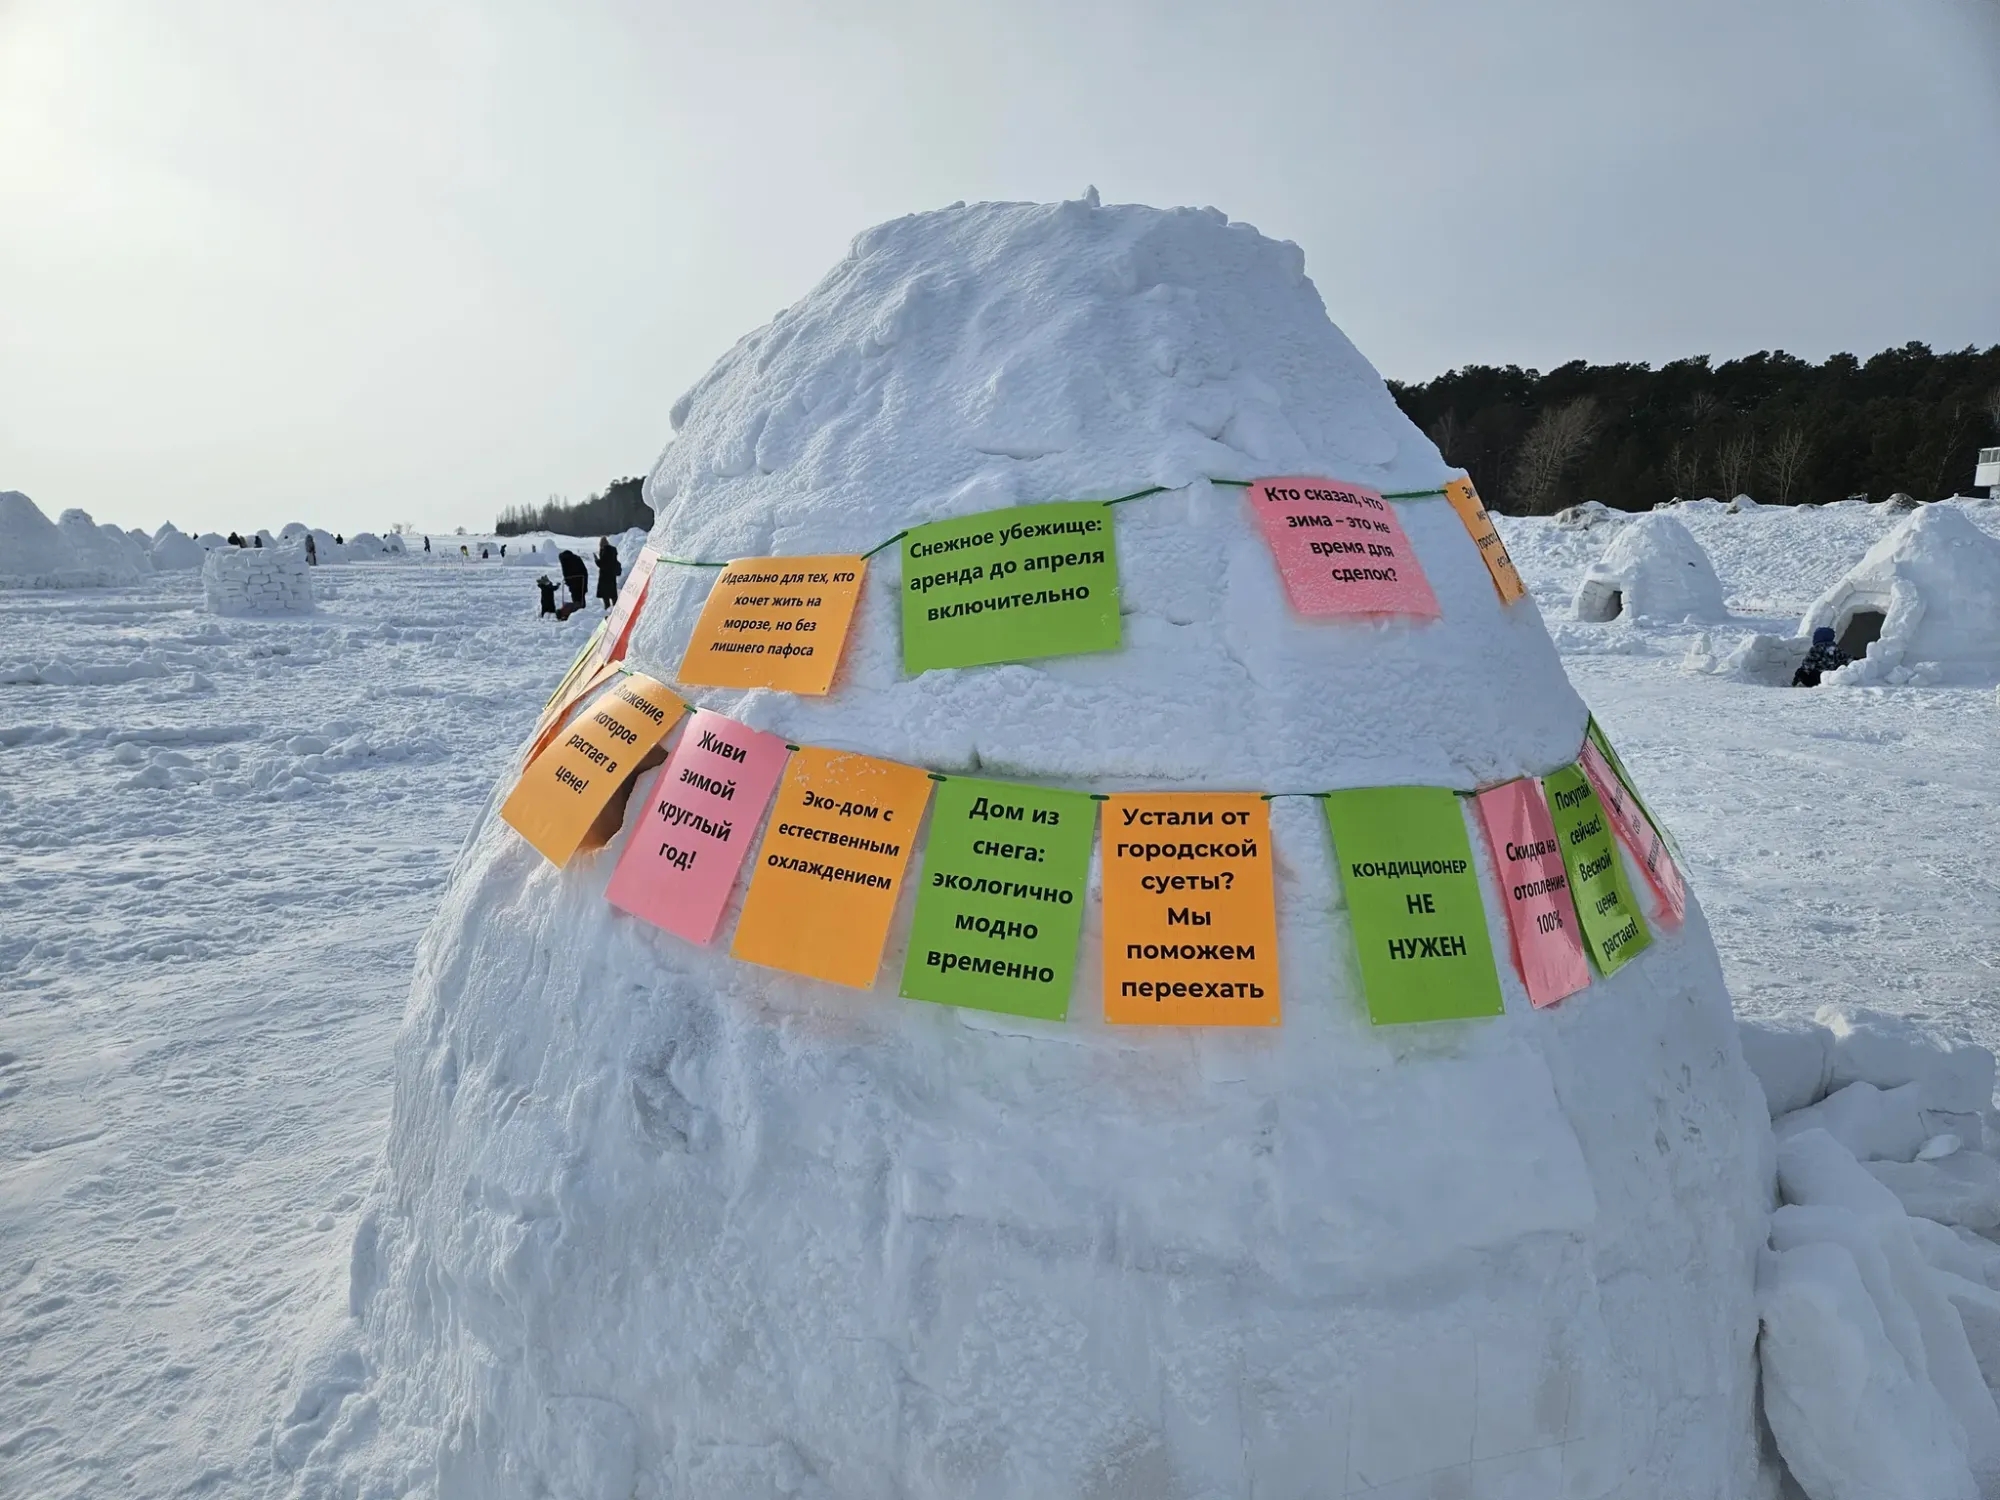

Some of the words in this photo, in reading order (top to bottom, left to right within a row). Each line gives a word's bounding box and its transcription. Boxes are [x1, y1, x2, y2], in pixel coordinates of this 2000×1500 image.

[1264, 487, 1300, 502] Кто
[1304, 490, 1362, 508] сказал,
[1363, 496, 1383, 511] что
[1286, 515, 1333, 528] зима
[1346, 516, 1372, 530] это
[1374, 519, 1390, 534] не
[909, 529, 994, 560] Снежное
[999, 517, 1102, 547] убежище:
[1310, 541, 1365, 558] время
[1367, 543, 1395, 558] для
[722, 570, 778, 585] Идеально
[780, 571, 803, 585] для
[805, 571, 830, 586] тех,
[833, 570, 855, 583] кто
[909, 563, 984, 595] аренда
[988, 559, 1017, 577] до
[1024, 548, 1105, 578] апреля
[1331, 567, 1398, 583] сделок?
[734, 595, 769, 607] хочет
[771, 595, 803, 607] жить
[806, 596, 822, 607] на
[927, 584, 1089, 621] включительно
[723, 618, 772, 632] морозе,
[776, 619, 792, 631] но
[794, 618, 817, 632] без
[710, 640, 764, 657] лишнего
[767, 641, 814, 658] пафоса
[614, 684, 665, 726] Вложение,
[593, 710, 637, 744] которое
[565, 733, 609, 766] растает
[606, 761, 618, 773] в
[697, 730, 747, 764] Живи
[554, 765, 590, 794] цене!
[679, 767, 736, 801] зимой
[802, 790, 879, 819] Эко-дом
[883, 808, 894, 822] с
[1554, 779, 1590, 811] Покупай
[657, 800, 732, 842] круглый
[969, 797, 1024, 821] Дом
[1032, 808, 1060, 825] из
[1122, 808, 1214, 826] Устали
[1221, 811, 1250, 826] от
[778, 821, 900, 857] естественным
[1569, 814, 1602, 845] сейчас!
[659, 841, 697, 870] год!
[972, 838, 1046, 862] снега:
[1117, 839, 1257, 862] городской
[1505, 842, 1545, 862] Скидка
[1546, 838, 1557, 854] на
[767, 853, 892, 890] охлаждением
[1351, 859, 1468, 880] КОНДИЦИОНЕР
[1579, 847, 1612, 882] Весной
[932, 872, 1074, 905] экологично
[1141, 872, 1234, 892] суеты?
[1513, 874, 1566, 901] отопление
[1406, 894, 1436, 915] НЕ
[1595, 891, 1619, 915] цена
[954, 913, 1039, 940] модно
[1167, 908, 1212, 926] Мы
[1536, 909, 1564, 934] 100%
[1127, 943, 1256, 960] поможем
[1387, 936, 1468, 960] НУЖЕН
[1602, 917, 1639, 961] растает!
[926, 950, 1055, 983] временно
[1121, 979, 1265, 1002] переехать
